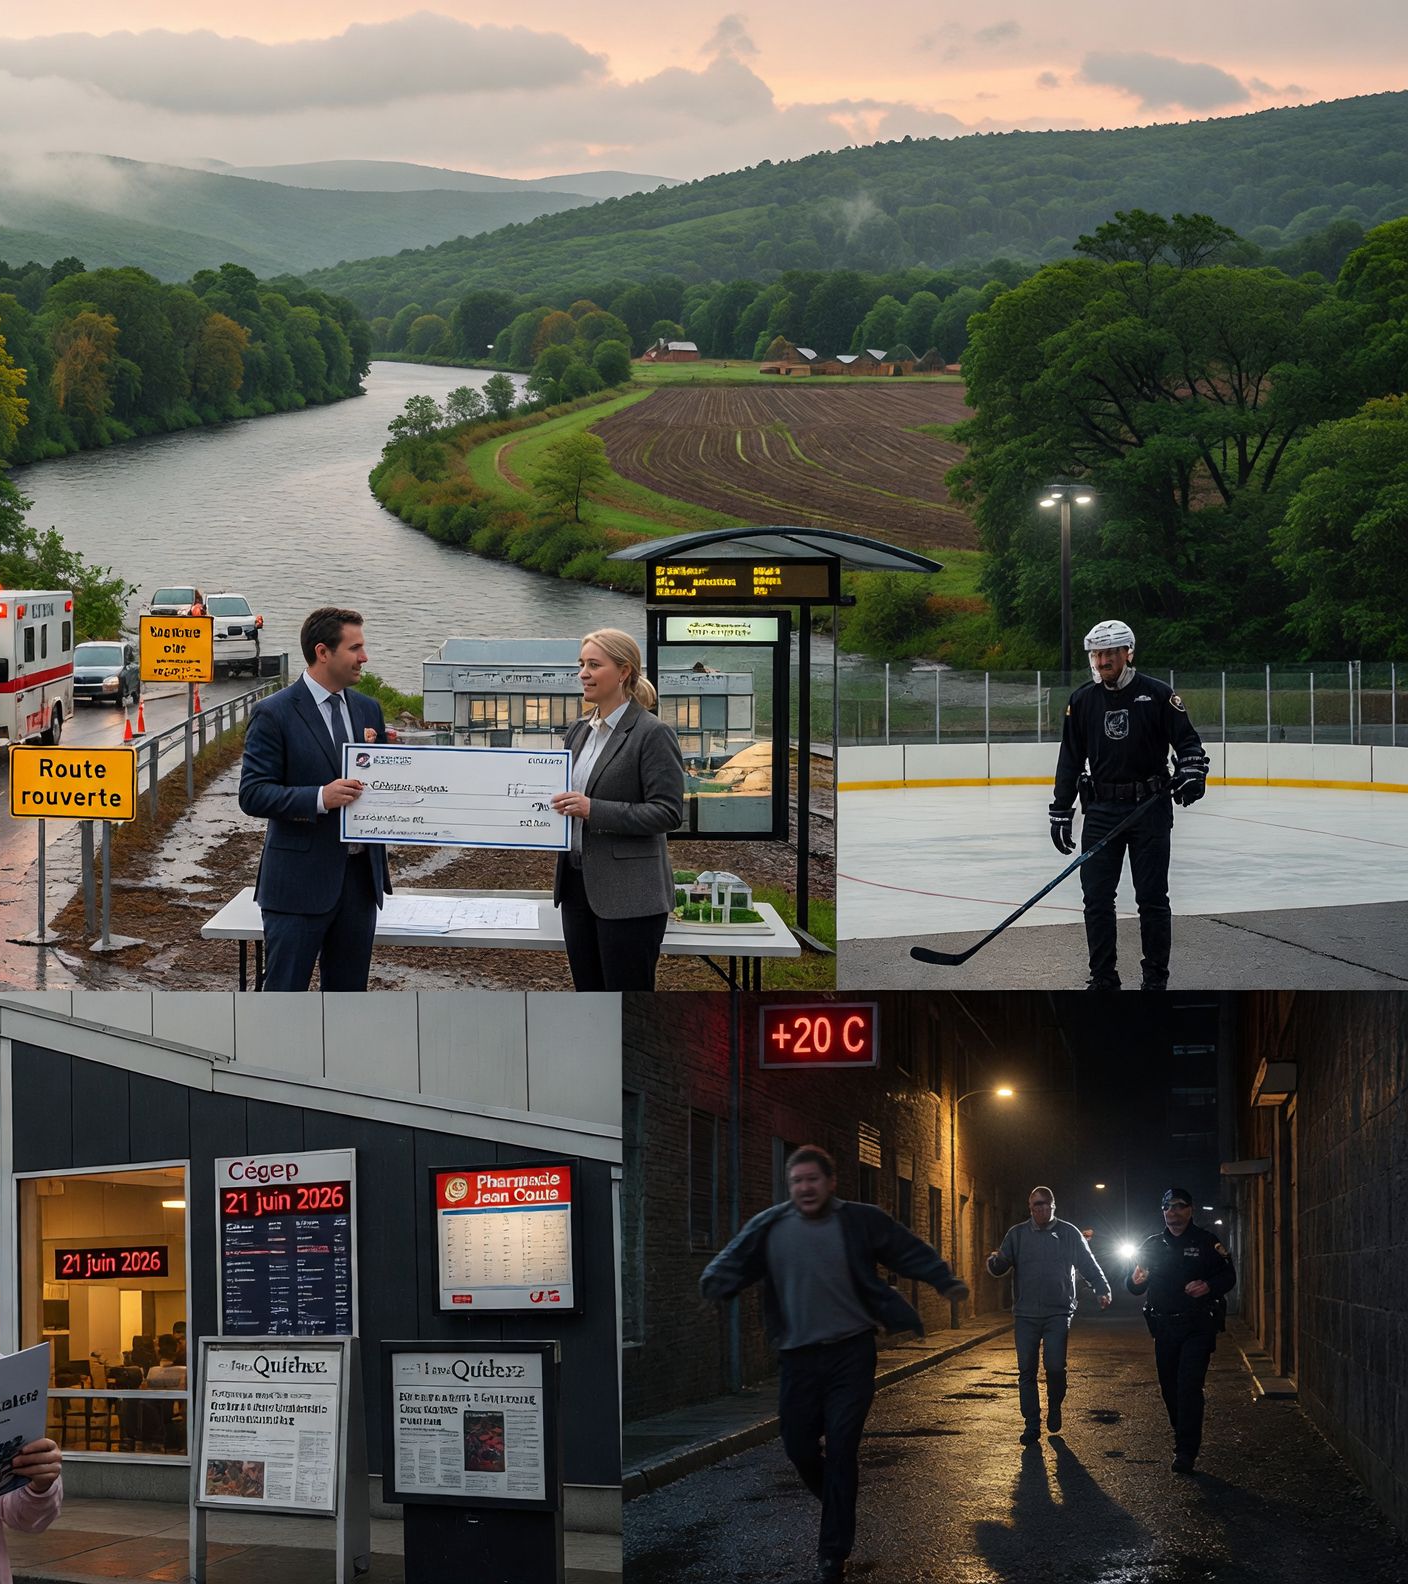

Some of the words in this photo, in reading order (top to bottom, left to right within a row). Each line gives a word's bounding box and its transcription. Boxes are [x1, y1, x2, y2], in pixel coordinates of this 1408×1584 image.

[39, 758, 106, 778] Route
[22, 788, 121, 807] rouverte
[772, 1016, 831, 1053] +20
[842, 1015, 865, 1053] C
[228, 1160, 299, 1183] Cégep
[225, 1192, 248, 1214] 21
[254, 1190, 291, 1217] juin
[296, 1186, 344, 1210] 2026
[62, 1253, 81, 1274] 21
[85, 1253, 116, 1277] juin
[120, 1251, 161, 1272] 2026
